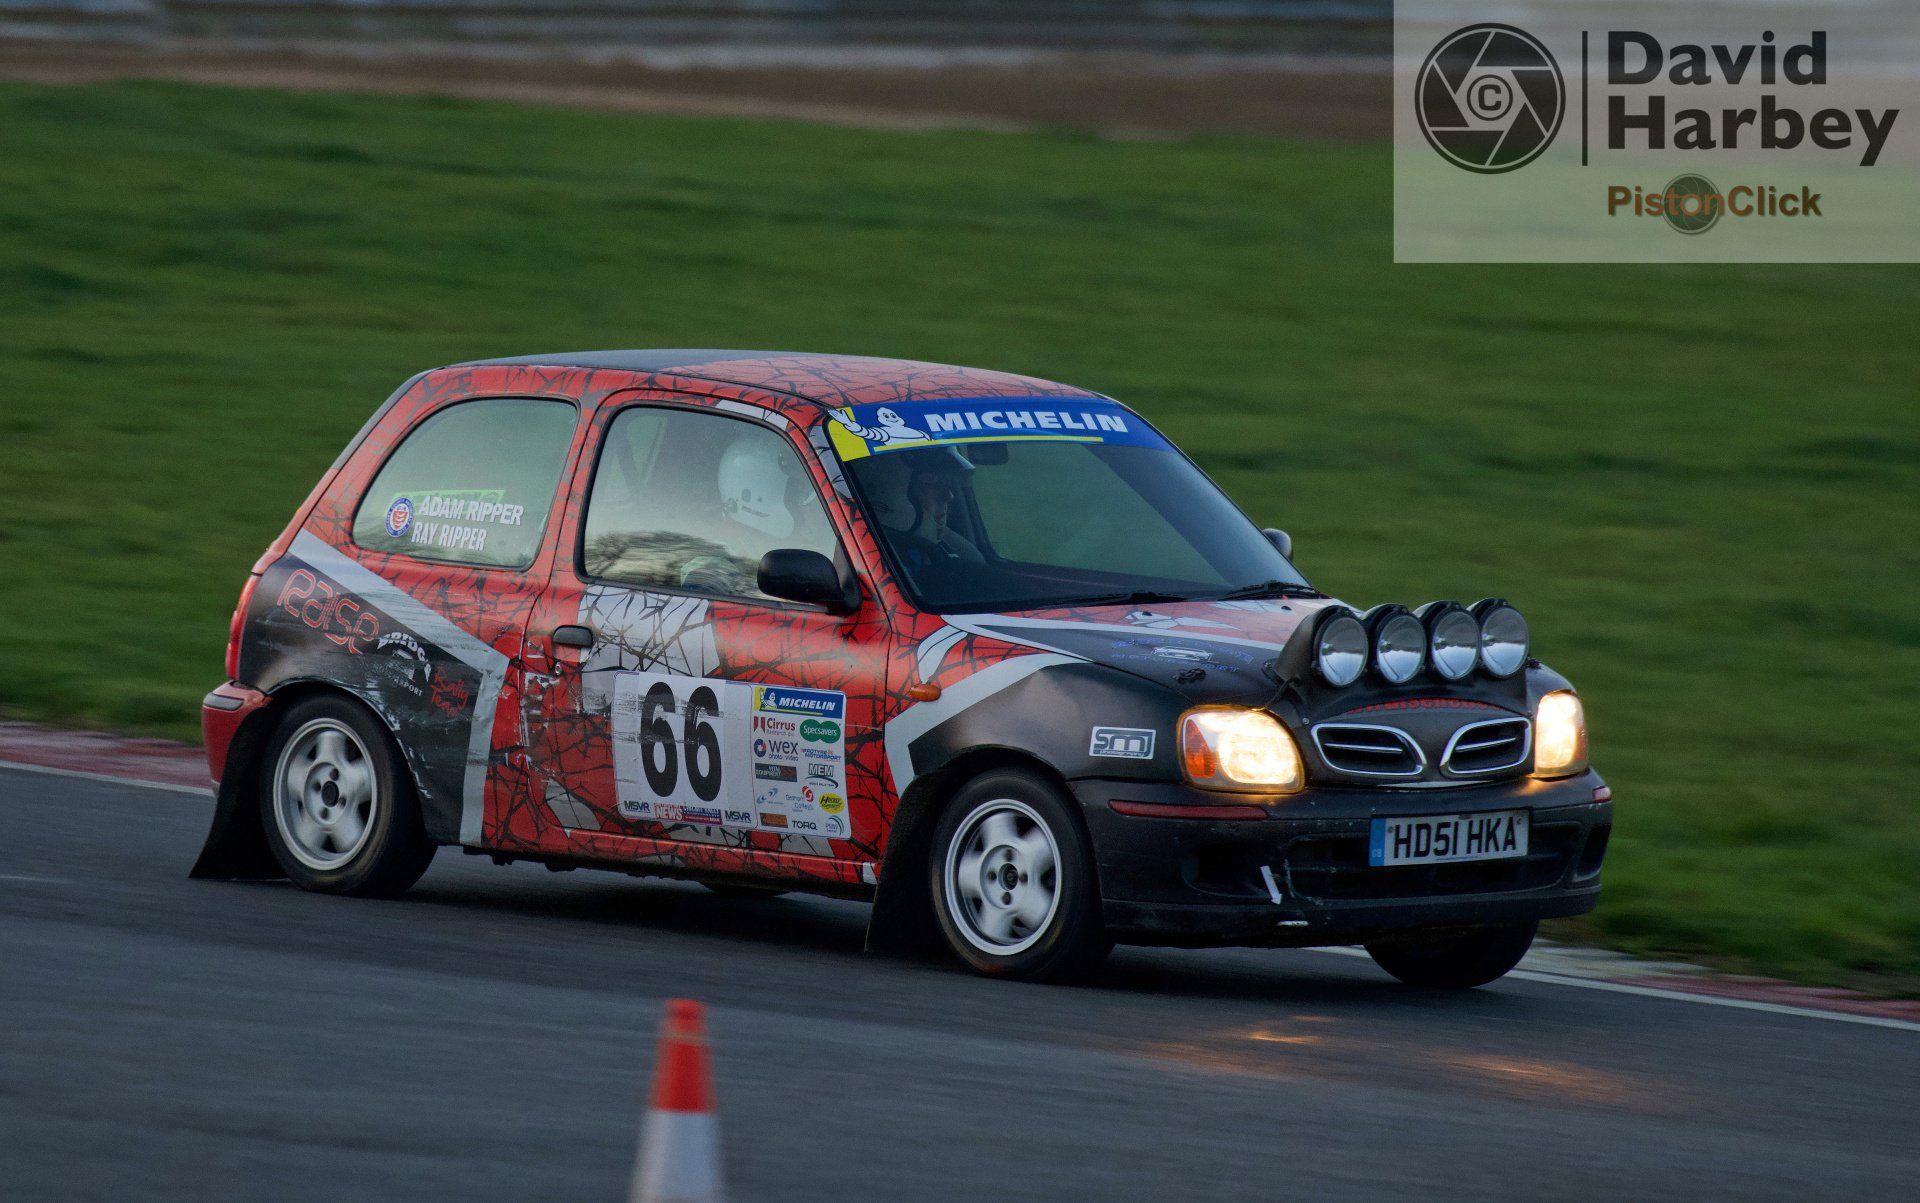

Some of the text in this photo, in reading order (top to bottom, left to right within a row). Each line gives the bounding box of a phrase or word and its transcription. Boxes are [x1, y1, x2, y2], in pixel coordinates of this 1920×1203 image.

[923, 411, 1128, 433] MICHELIN
[419, 495, 465, 518] ADAM
[465, 500, 524, 526] RIPPER
[411, 521, 487, 551] RAY RIPPER
[779, 697, 836, 711] MICHELIN
[767, 718, 796, 731] Cirrus
[803, 724, 838, 737] Specsavers
[641, 681, 722, 802] 66
[769, 740, 799, 755] wex
[769, 752, 783, 761] photo
[808, 763, 835, 778] MEM
[624, 800, 650, 811] MSVR
[654, 805, 683, 821] NEWS
[724, 810, 751, 821] MSVR
[791, 820, 818, 831] TORQ
[1393, 816, 1518, 859] HD51 HKA
